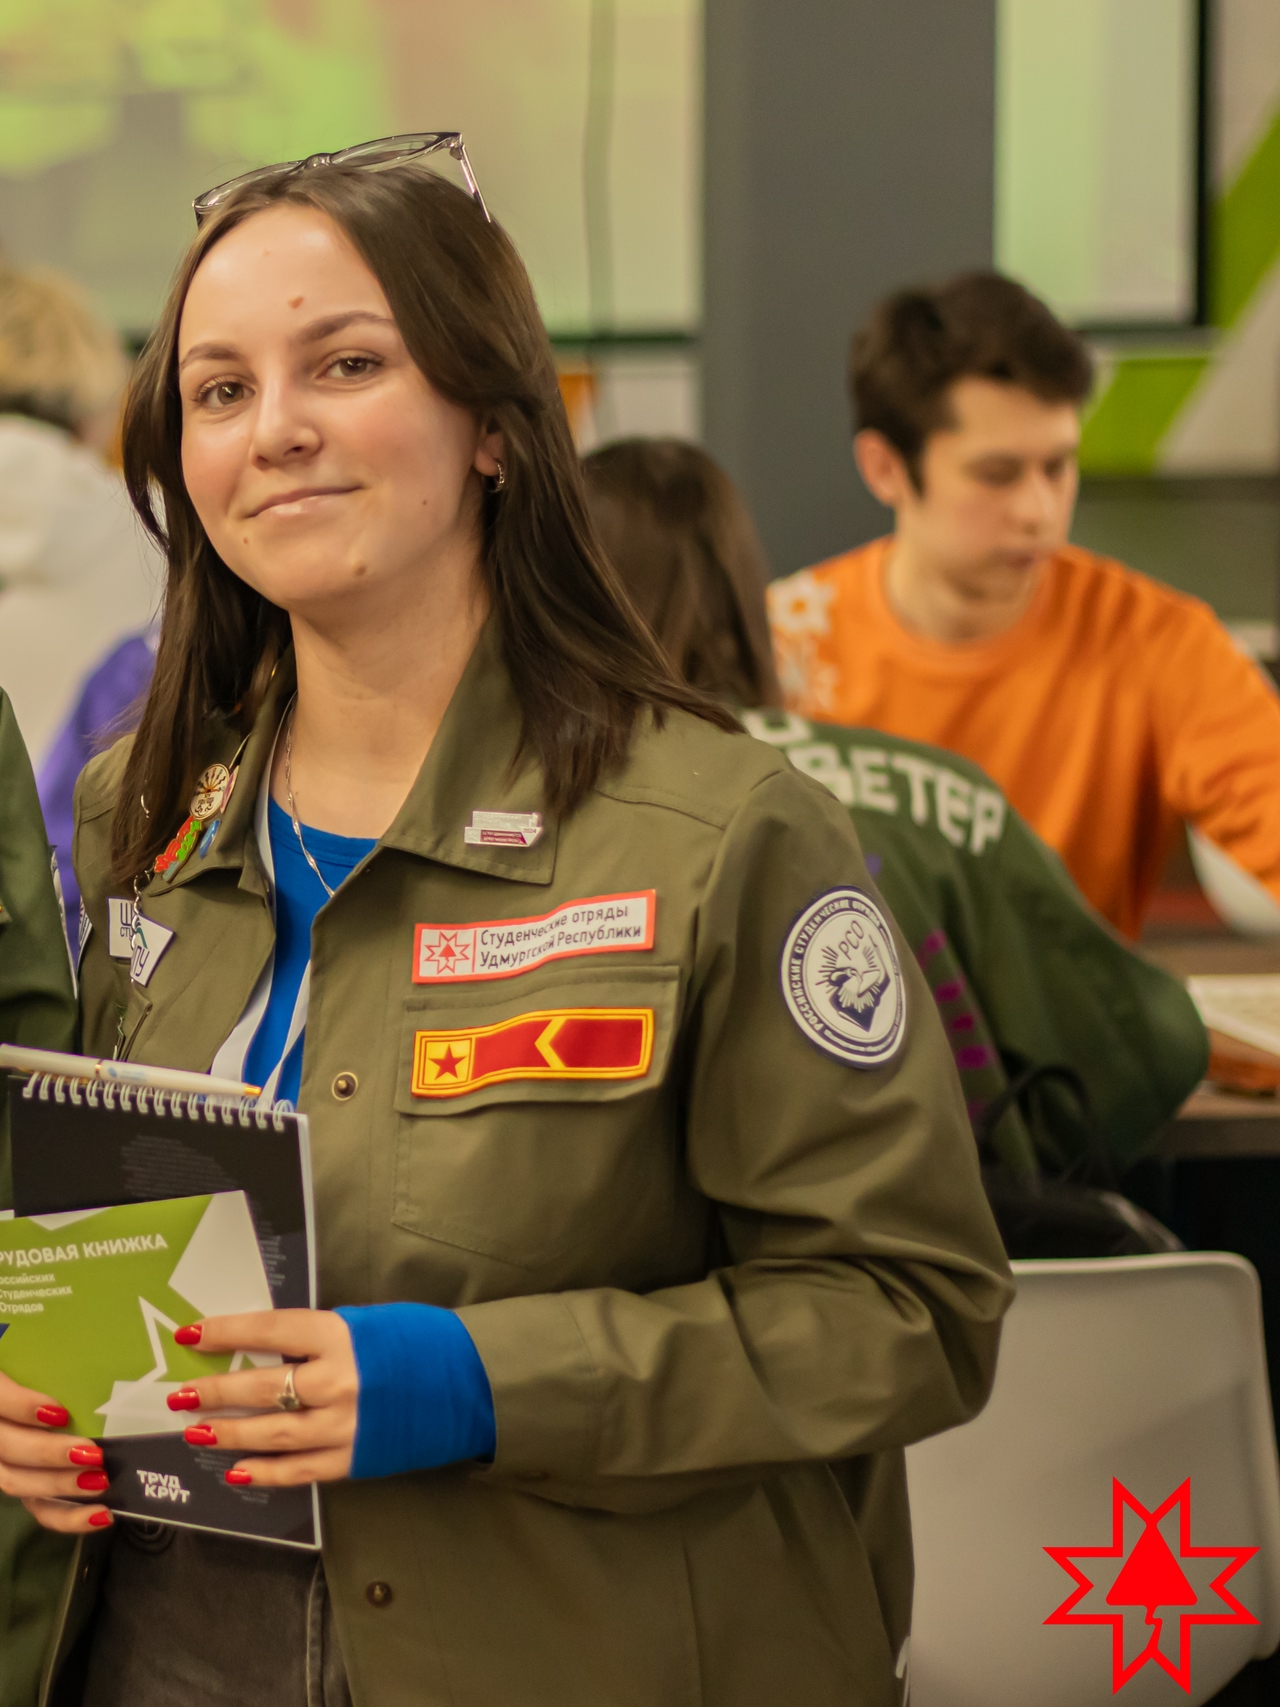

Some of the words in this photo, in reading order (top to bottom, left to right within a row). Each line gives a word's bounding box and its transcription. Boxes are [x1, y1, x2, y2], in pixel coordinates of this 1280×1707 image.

[480, 933, 555, 969] Удмуртской
[557, 924, 641, 947] Республики
[481, 915, 568, 949] Студенческие
[571, 905, 628, 925] отряды
[838, 920, 865, 961] РСО
[790, 957, 824, 1031] РОССИЙСКИЕ
[82, 1233, 168, 1258] КНИЖКА
[136, 1469, 181, 1489] ТРУД
[145, 1484, 191, 1503] КРУТ
